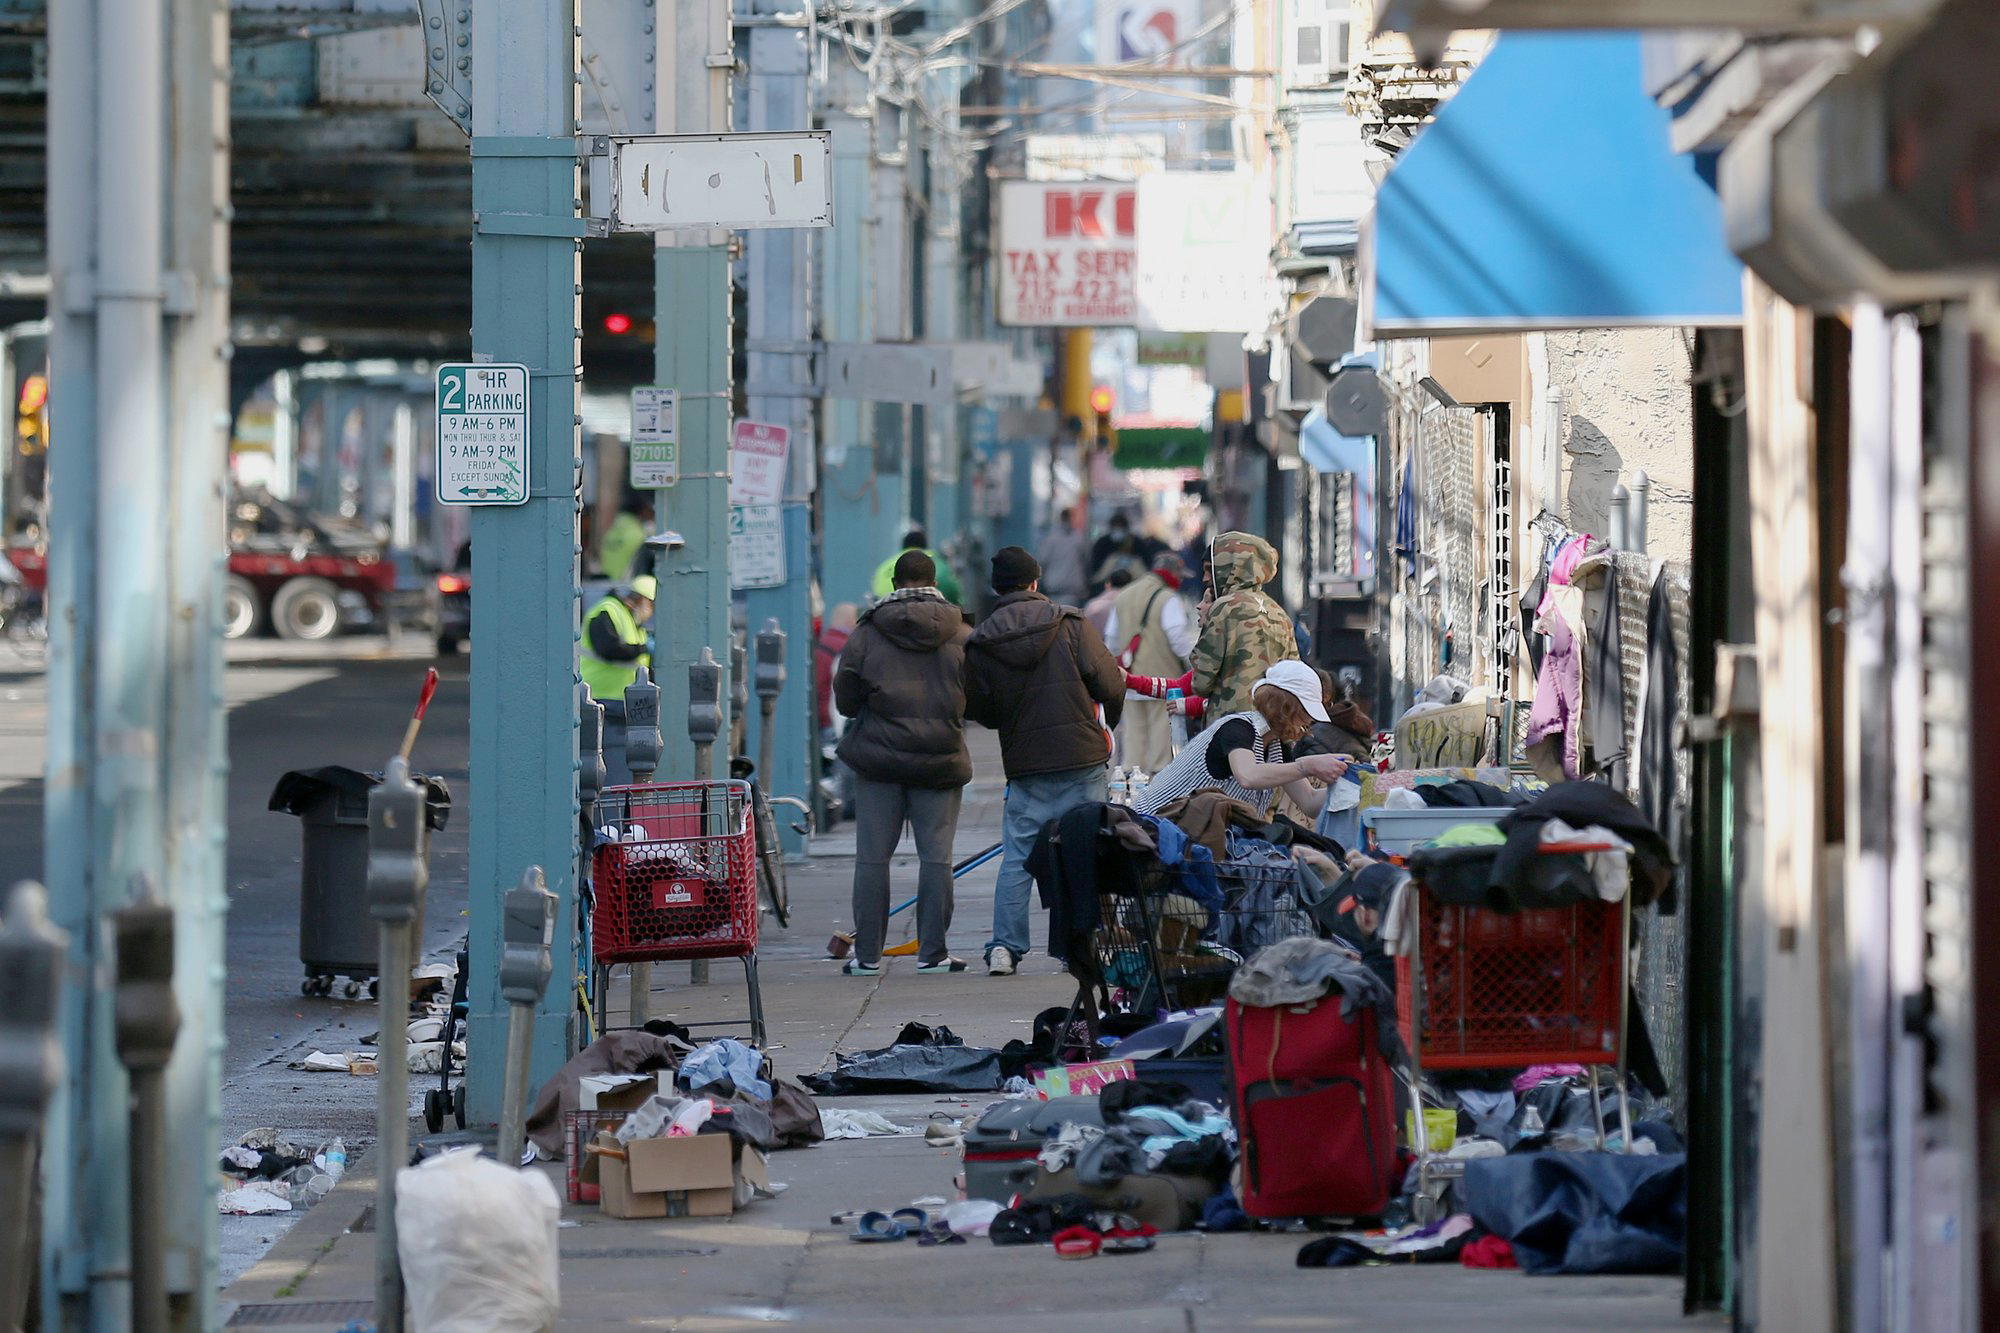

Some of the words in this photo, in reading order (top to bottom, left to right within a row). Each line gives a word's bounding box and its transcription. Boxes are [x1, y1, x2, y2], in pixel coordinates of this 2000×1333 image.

[1006, 251, 1060, 274] TAX
[1075, 251, 1136, 275] SER
[485, 371, 507, 388] HR
[442, 375, 462, 410] 2
[467, 393, 522, 410] PARKING
[450, 417, 457, 430] 9
[499, 417, 516, 430] PM
[443, 433, 458, 442] MON
[460, 433, 477, 442] THRU
[480, 433, 496, 442] THUR
[499, 433, 506, 442] &
[509, 433, 521, 442] SAT
[450, 445, 457, 458] 9
[499, 445, 516, 458] PM
[468, 461, 497, 470] FRIDAY
[451, 473, 480, 482] EXCEPT
